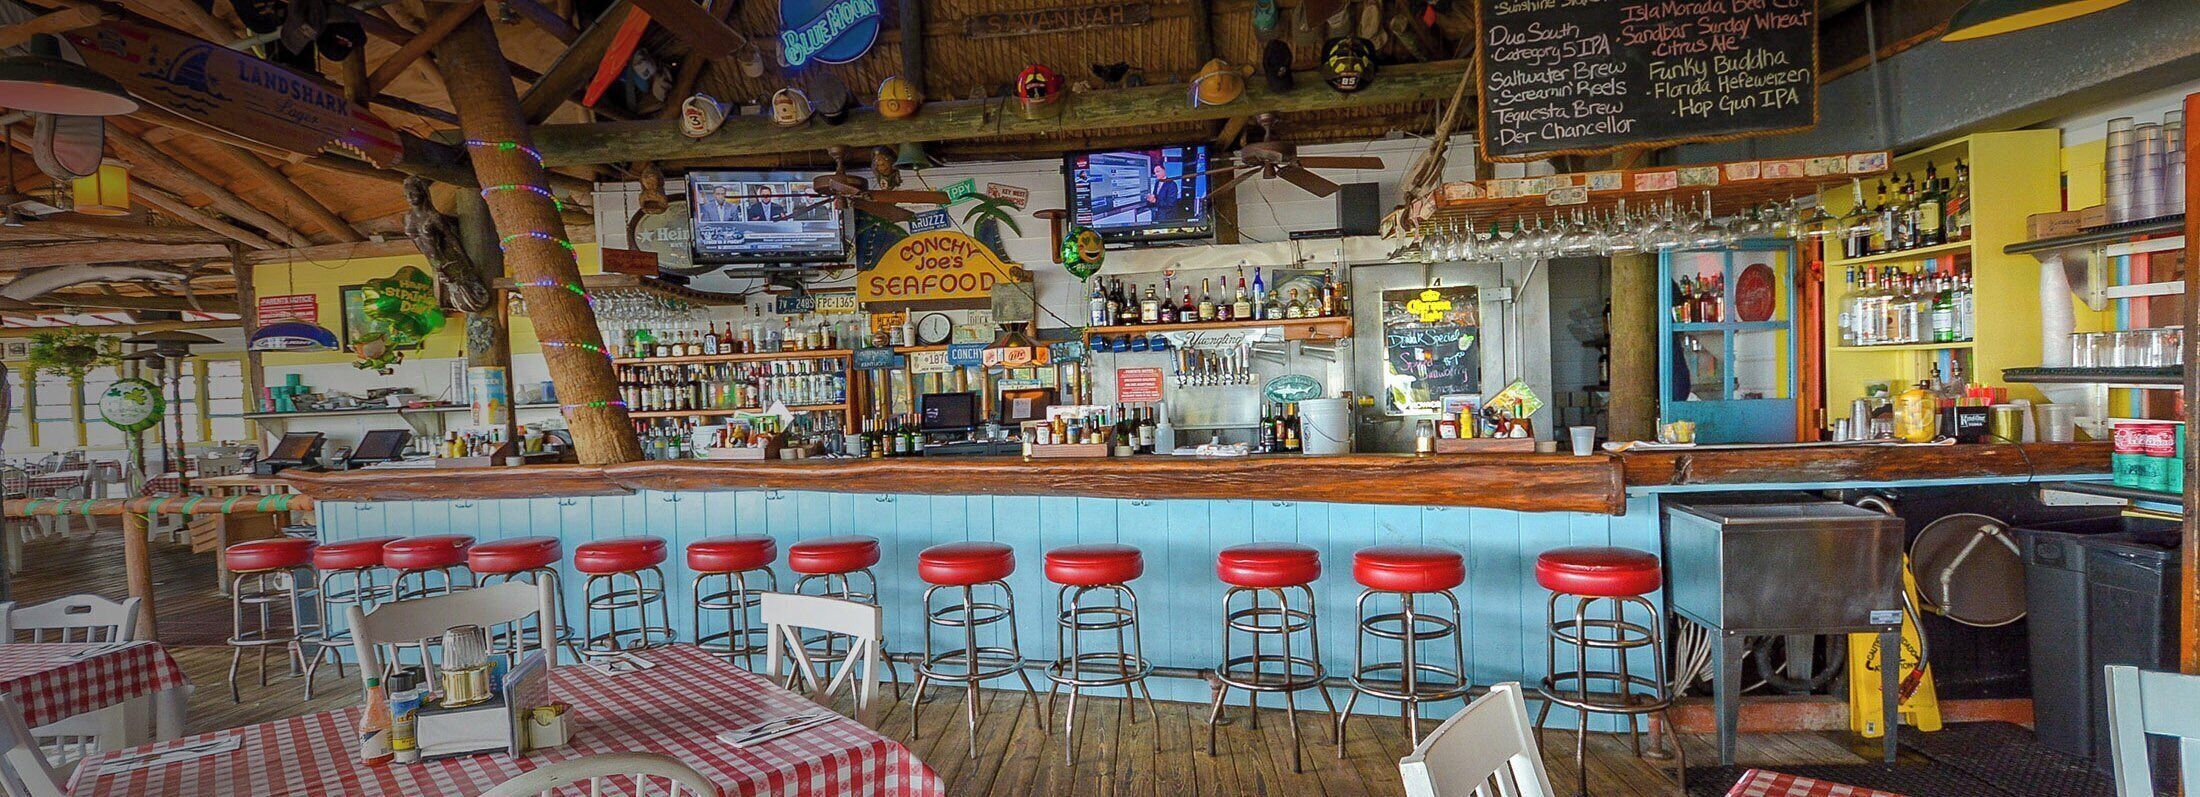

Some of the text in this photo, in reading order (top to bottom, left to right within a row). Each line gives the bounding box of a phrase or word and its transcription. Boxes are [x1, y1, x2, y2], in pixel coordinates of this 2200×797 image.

[782, 0, 877, 65] BLUE MOON
[987, 6, 1124, 33] SAVANNAH
[1528, 22, 1580, 42] South
[1622, 24, 1693, 46] Sandbar
[1755, 12, 1812, 30] Wheat
[1494, 34, 1610, 66] Category 5 IPA
[1710, 35, 1739, 51] Ale
[1714, 48, 1790, 74] Buddha
[239, 59, 347, 116] LANDSHARK
[1488, 62, 1627, 91] Saltwater Brew
[1577, 78, 1627, 97] Reels
[1655, 68, 1810, 99] Florida Hefeweizen
[1492, 100, 1623, 128] Tequesta Brew
[1679, 87, 1799, 118] Hop Gun IPA
[689, 116, 701, 125] 3
[1500, 115, 1636, 146] Der Chancellor
[900, 237, 981, 262] CONCHY
[915, 255, 963, 271] Joe's
[870, 272, 995, 297] SEAFOOD
[1185, 331, 1245, 350] Yuengling
[1424, 329, 1460, 346] Special
